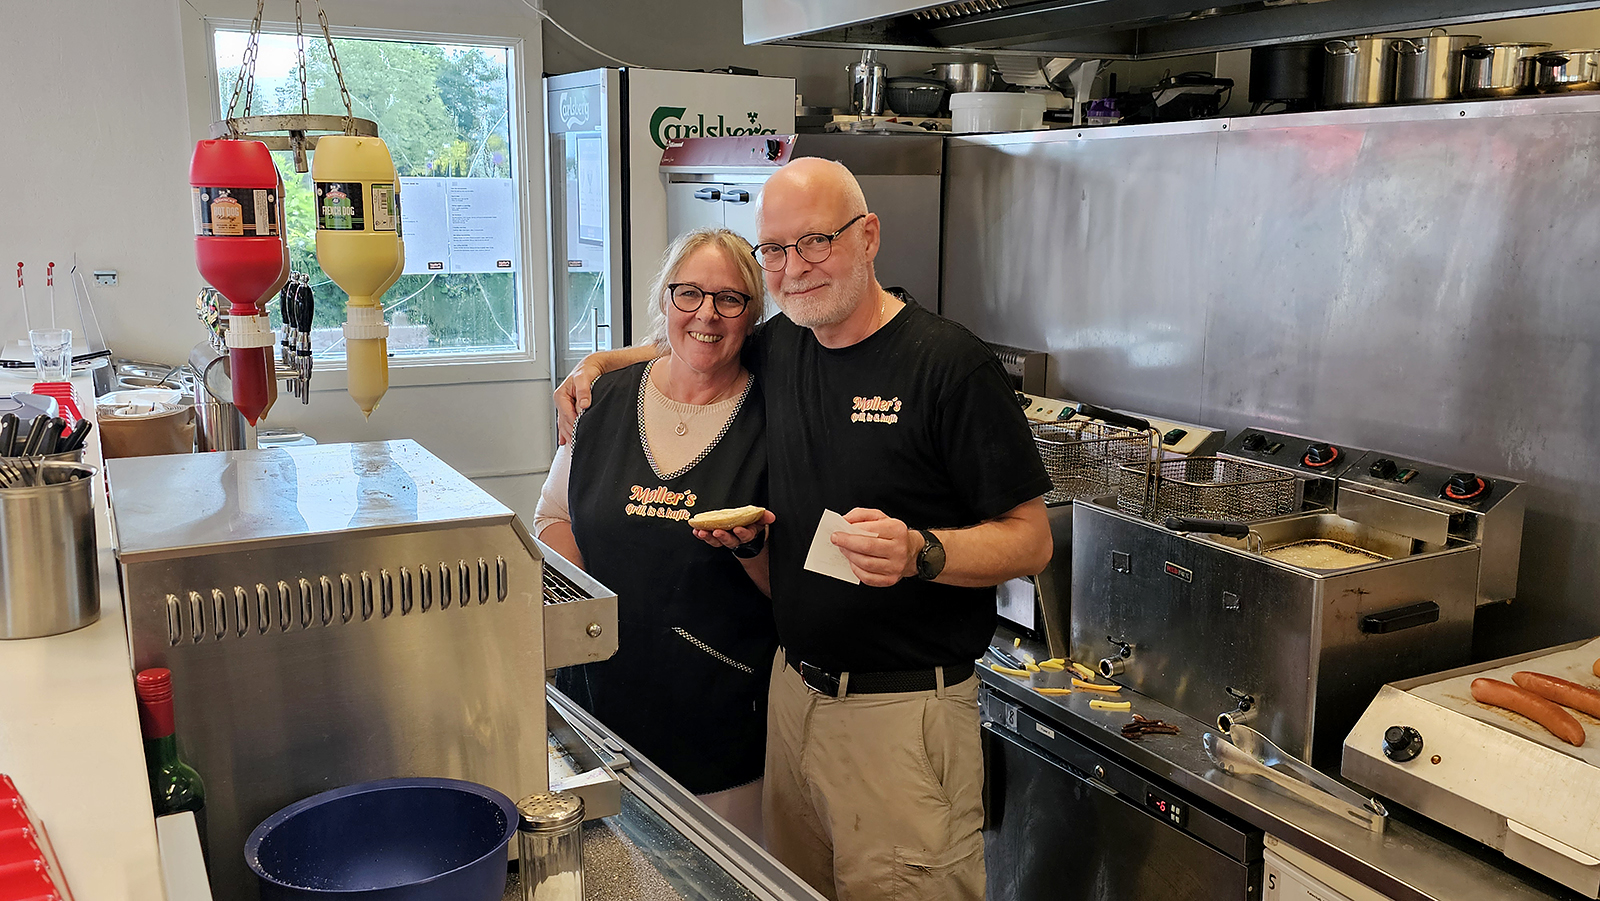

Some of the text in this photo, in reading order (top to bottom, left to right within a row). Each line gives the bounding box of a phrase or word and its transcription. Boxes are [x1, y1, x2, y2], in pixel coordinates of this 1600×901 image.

[560, 92, 590, 123] Carlsberg
[213, 206, 240, 217] HOT DOG
[322, 205, 355, 216] FRENCH DOG
[656, 506, 666, 518] &
[666, 507, 691, 521] kaffe
[1008, 709, 1016, 725] 8
